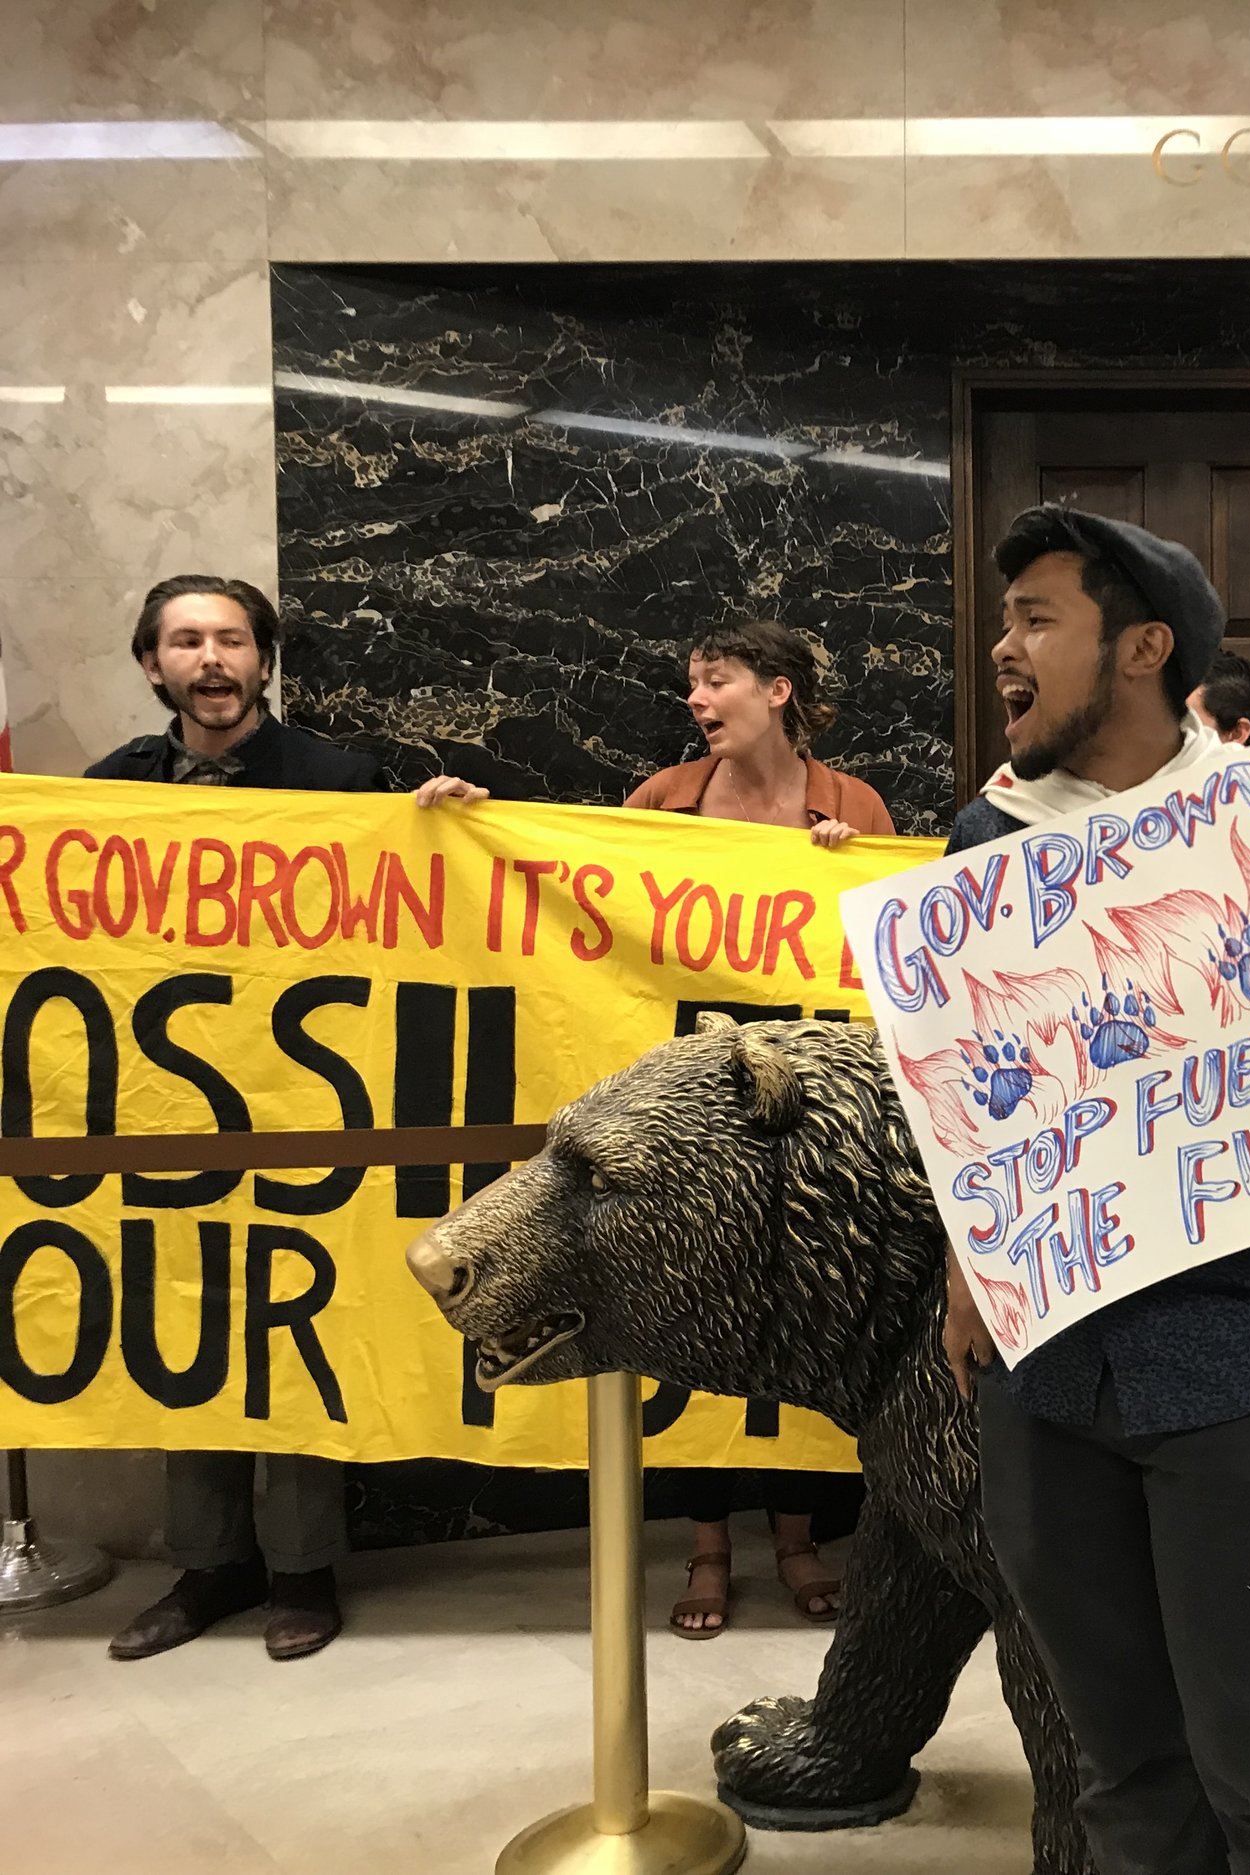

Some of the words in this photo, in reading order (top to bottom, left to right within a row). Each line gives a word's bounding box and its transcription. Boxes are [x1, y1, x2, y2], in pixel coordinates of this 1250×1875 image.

[486, 856, 615, 962] IT'S
[640, 870, 816, 981] YOUR
[874, 854, 1013, 1013] GOV.
[951, 1097, 1118, 1256] STOP
[1008, 1181, 1135, 1319] THE
[0, 1219, 349, 1424] OUR
